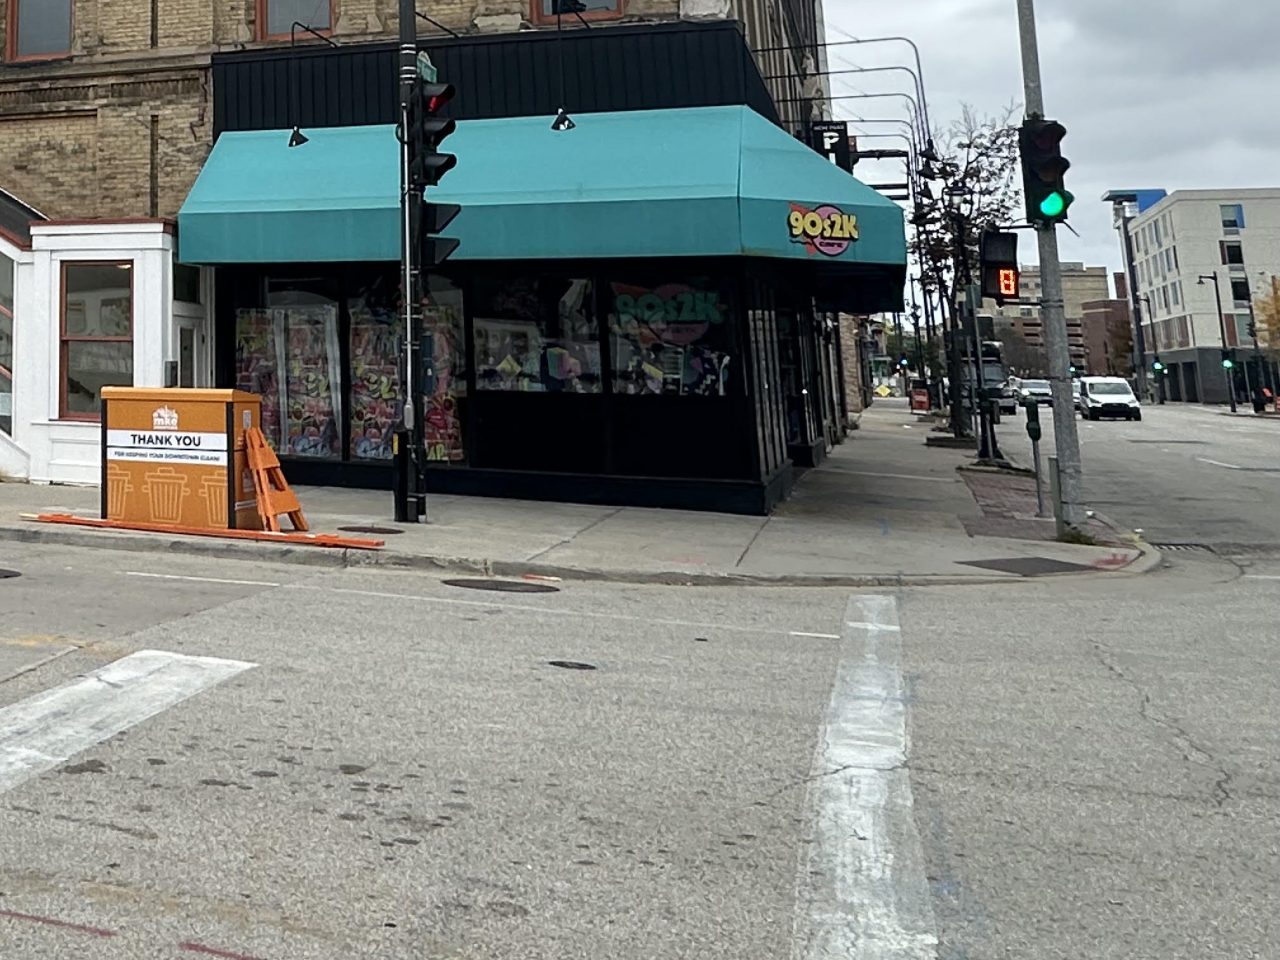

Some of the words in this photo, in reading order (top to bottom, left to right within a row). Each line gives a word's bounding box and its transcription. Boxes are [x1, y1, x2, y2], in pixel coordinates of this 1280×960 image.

[999, 270, 1016, 294] 8
[131, 434, 172, 446] THANK
[175, 436, 201, 447] YOU
